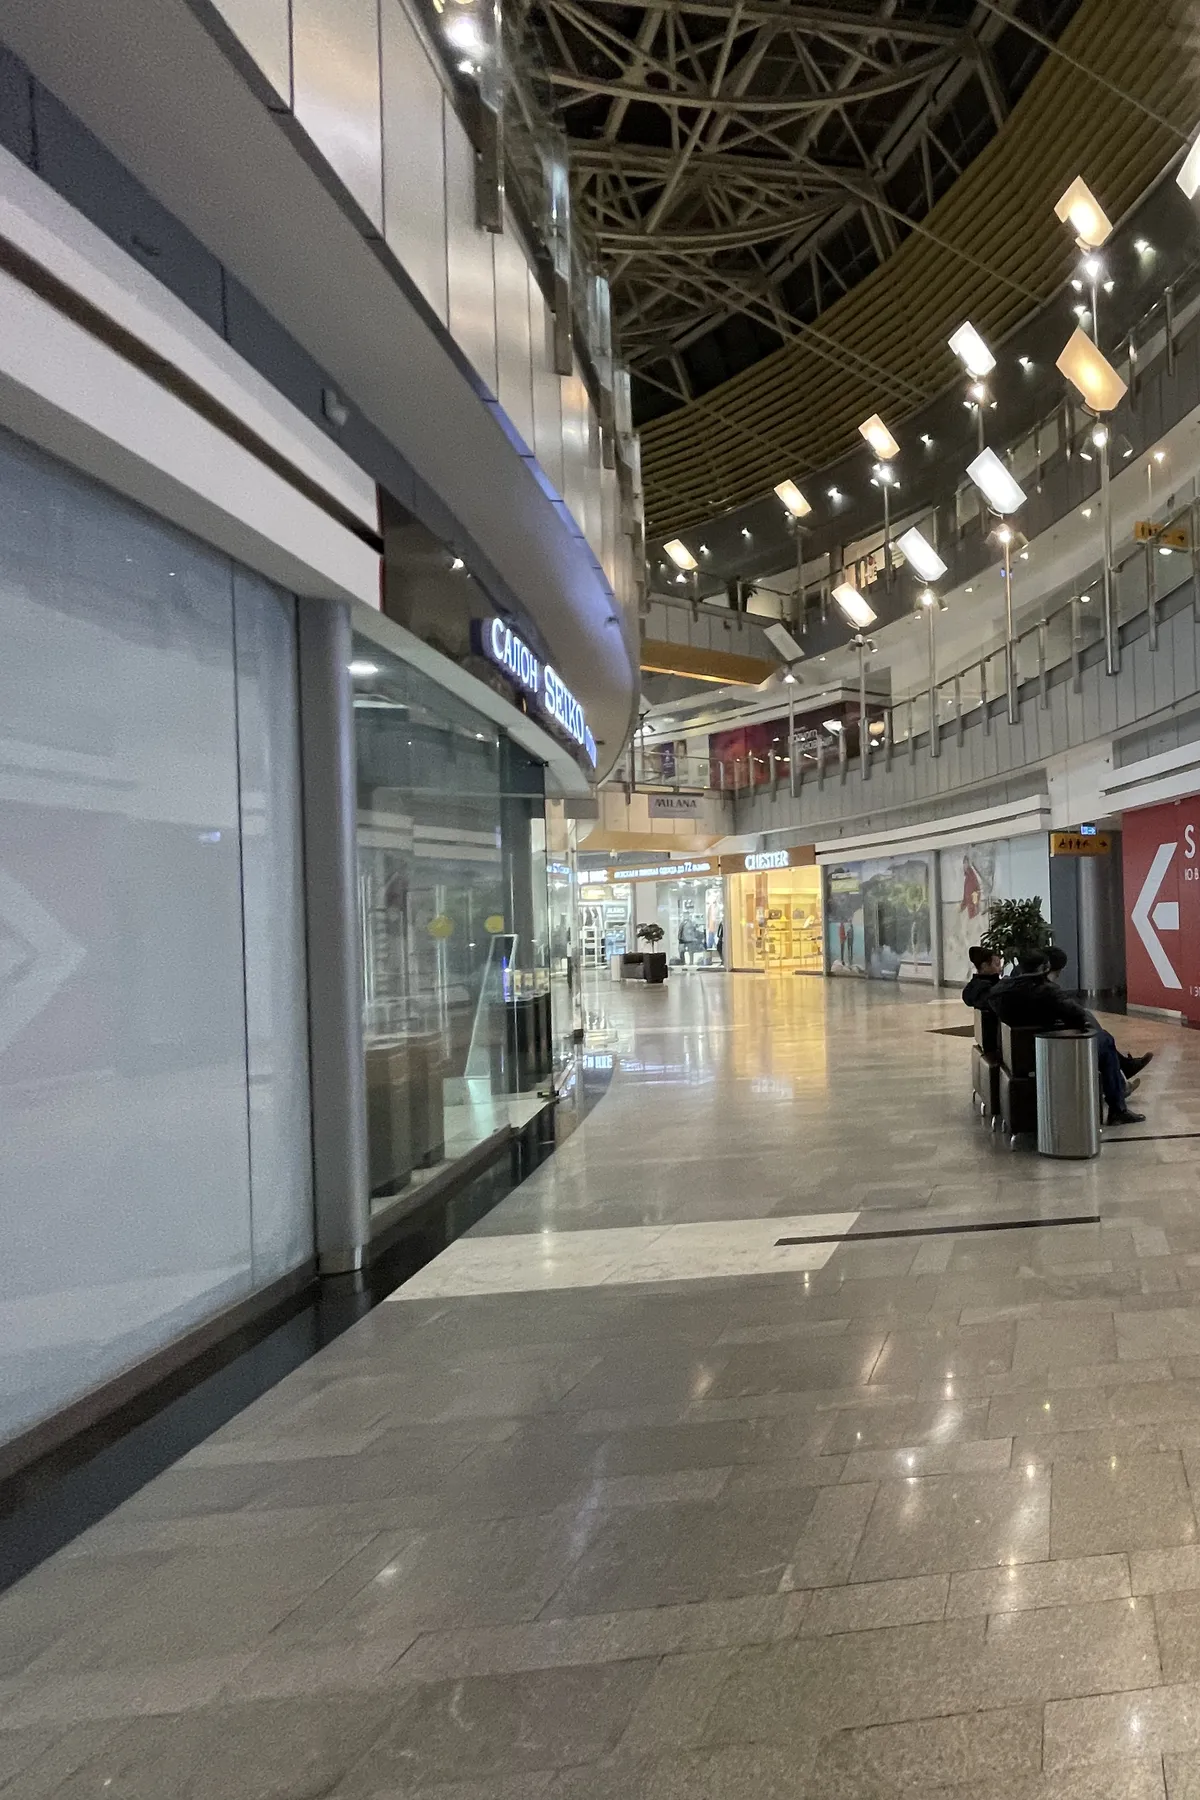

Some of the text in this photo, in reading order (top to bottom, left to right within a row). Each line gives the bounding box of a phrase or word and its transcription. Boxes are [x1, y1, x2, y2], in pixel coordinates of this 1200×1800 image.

[491, 617, 585, 745] САЛОН SEIKO
[654, 799, 697, 808] MILANA
[744, 850, 789, 871] CHESTER
